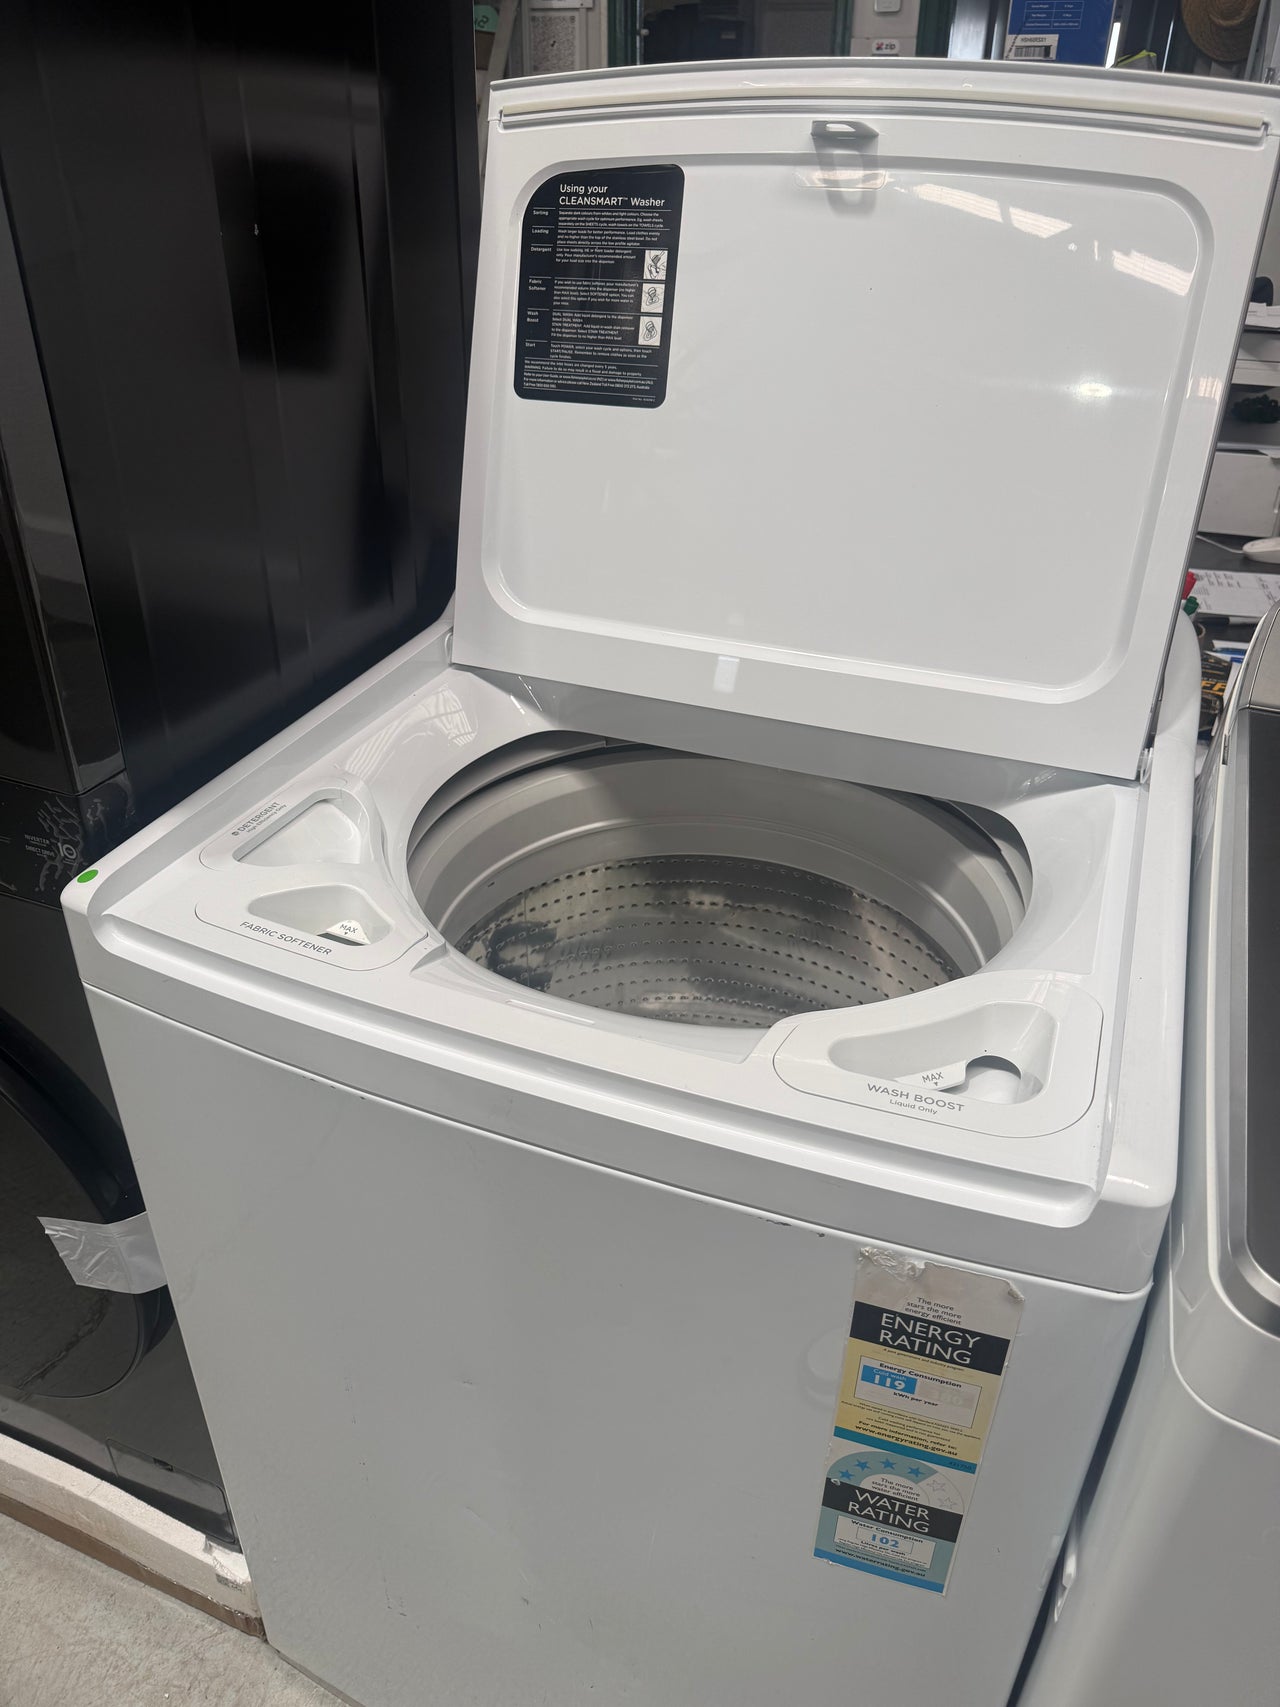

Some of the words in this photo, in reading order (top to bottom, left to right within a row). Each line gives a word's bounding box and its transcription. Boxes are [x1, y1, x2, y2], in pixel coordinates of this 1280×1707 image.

[560, 184, 585, 194] Using
[588, 185, 608, 195] your
[630, 198, 665, 207] Washer
[238, 802, 280, 832] DETERGENT
[339, 924, 358, 934] MAX
[240, 921, 278, 937] FABRIC
[277, 933, 332, 955] SOFTENER
[922, 1072, 944, 1083] MAX
[867, 1083, 910, 1100] WASH
[914, 1094, 965, 1112] BOOST
[889, 1098, 916, 1110] Liquid
[918, 1105, 938, 1115] Only
[907, 1302, 925, 1310] stars
[941, 1310, 962, 1319] more
[918, 1297, 931, 1305] The
[934, 1302, 954, 1311] more
[905, 1307, 930, 1317] energy
[932, 1314, 961, 1325] efficient
[881, 1313, 982, 1349] ENERGY
[880, 1330, 972, 1364] RATING
[874, 1374, 905, 1390] 119
[880, 1363, 907, 1374] Energy
[909, 1370, 962, 1388] Consumption
[894, 1391, 910, 1400] kWh
[855, 1425, 958, 1456] www.energyrating.gov.au
[870, 1424, 888, 1432] more
[889, 1428, 929, 1443] information,
[930, 1440, 946, 1448] refer
[871, 1486, 891, 1494] water
[892, 1491, 919, 1501] efficient
[872, 1481, 888, 1489] stars
[903, 1489, 921, 1497] more
[895, 1482, 914, 1490] more
[855, 1490, 930, 1520] WATER
[848, 1501, 930, 1533] RATING
[851, 1520, 874, 1530] Water
[876, 1527, 923, 1544] Consumption
[860, 1540, 878, 1549] Litres
[891, 1548, 906, 1556] wash
[872, 1534, 899, 1548] 102
[835, 1549, 926, 1577] www.waterrating.gov.au
